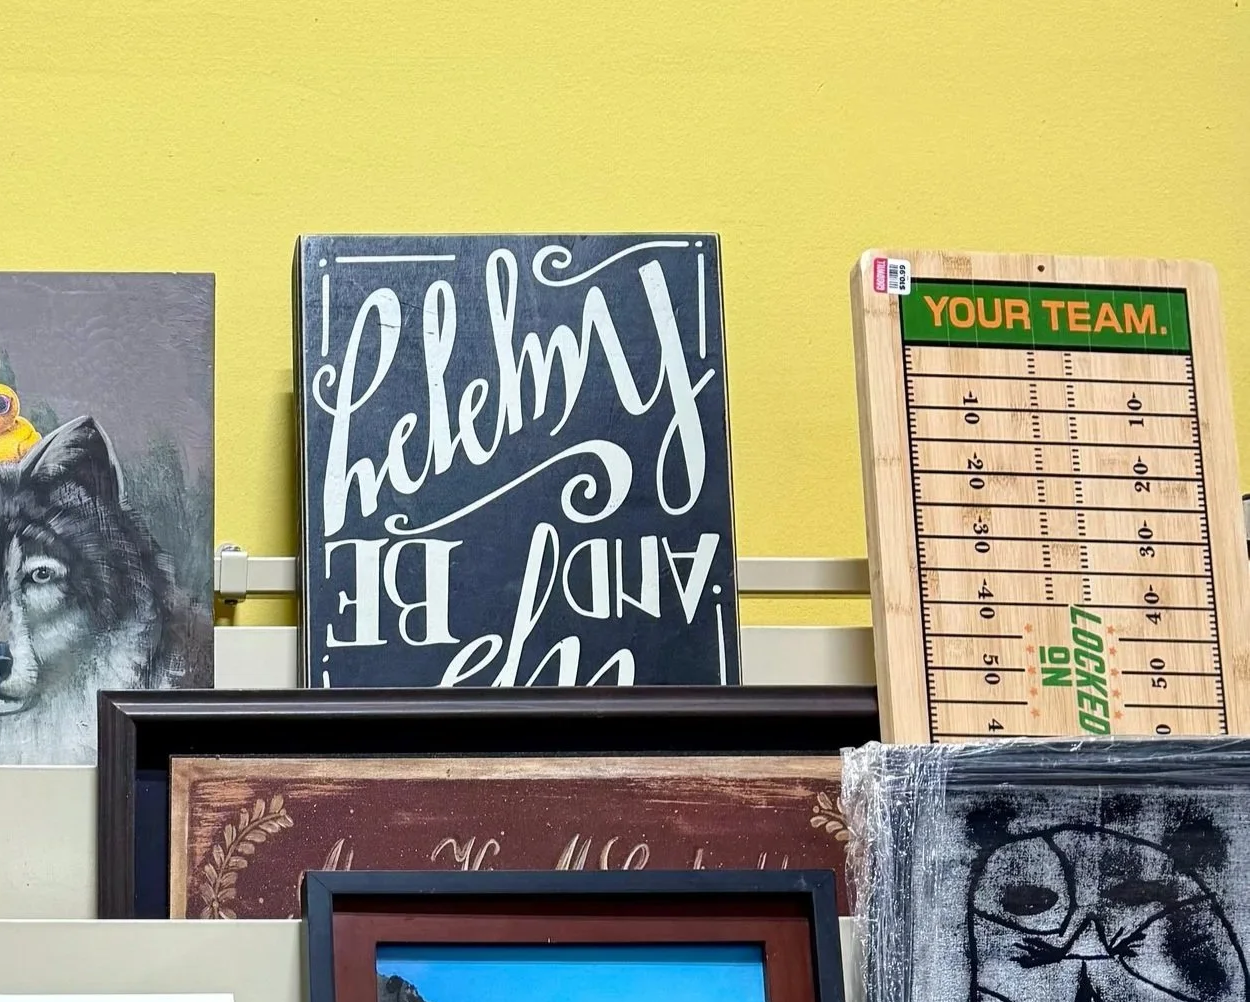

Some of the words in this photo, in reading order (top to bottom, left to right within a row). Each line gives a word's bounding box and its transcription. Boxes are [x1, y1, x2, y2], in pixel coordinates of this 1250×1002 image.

[923, 295, 1031, 330] YOUR
[1041, 300, 1168, 335] TEAM.
[313, 248, 716, 537] happy
[326, 538, 463, 647] BE
[563, 534, 719, 623] AND
[1039, 646, 1073, 687] ON
[1070, 606, 1111, 735] LOCKED
